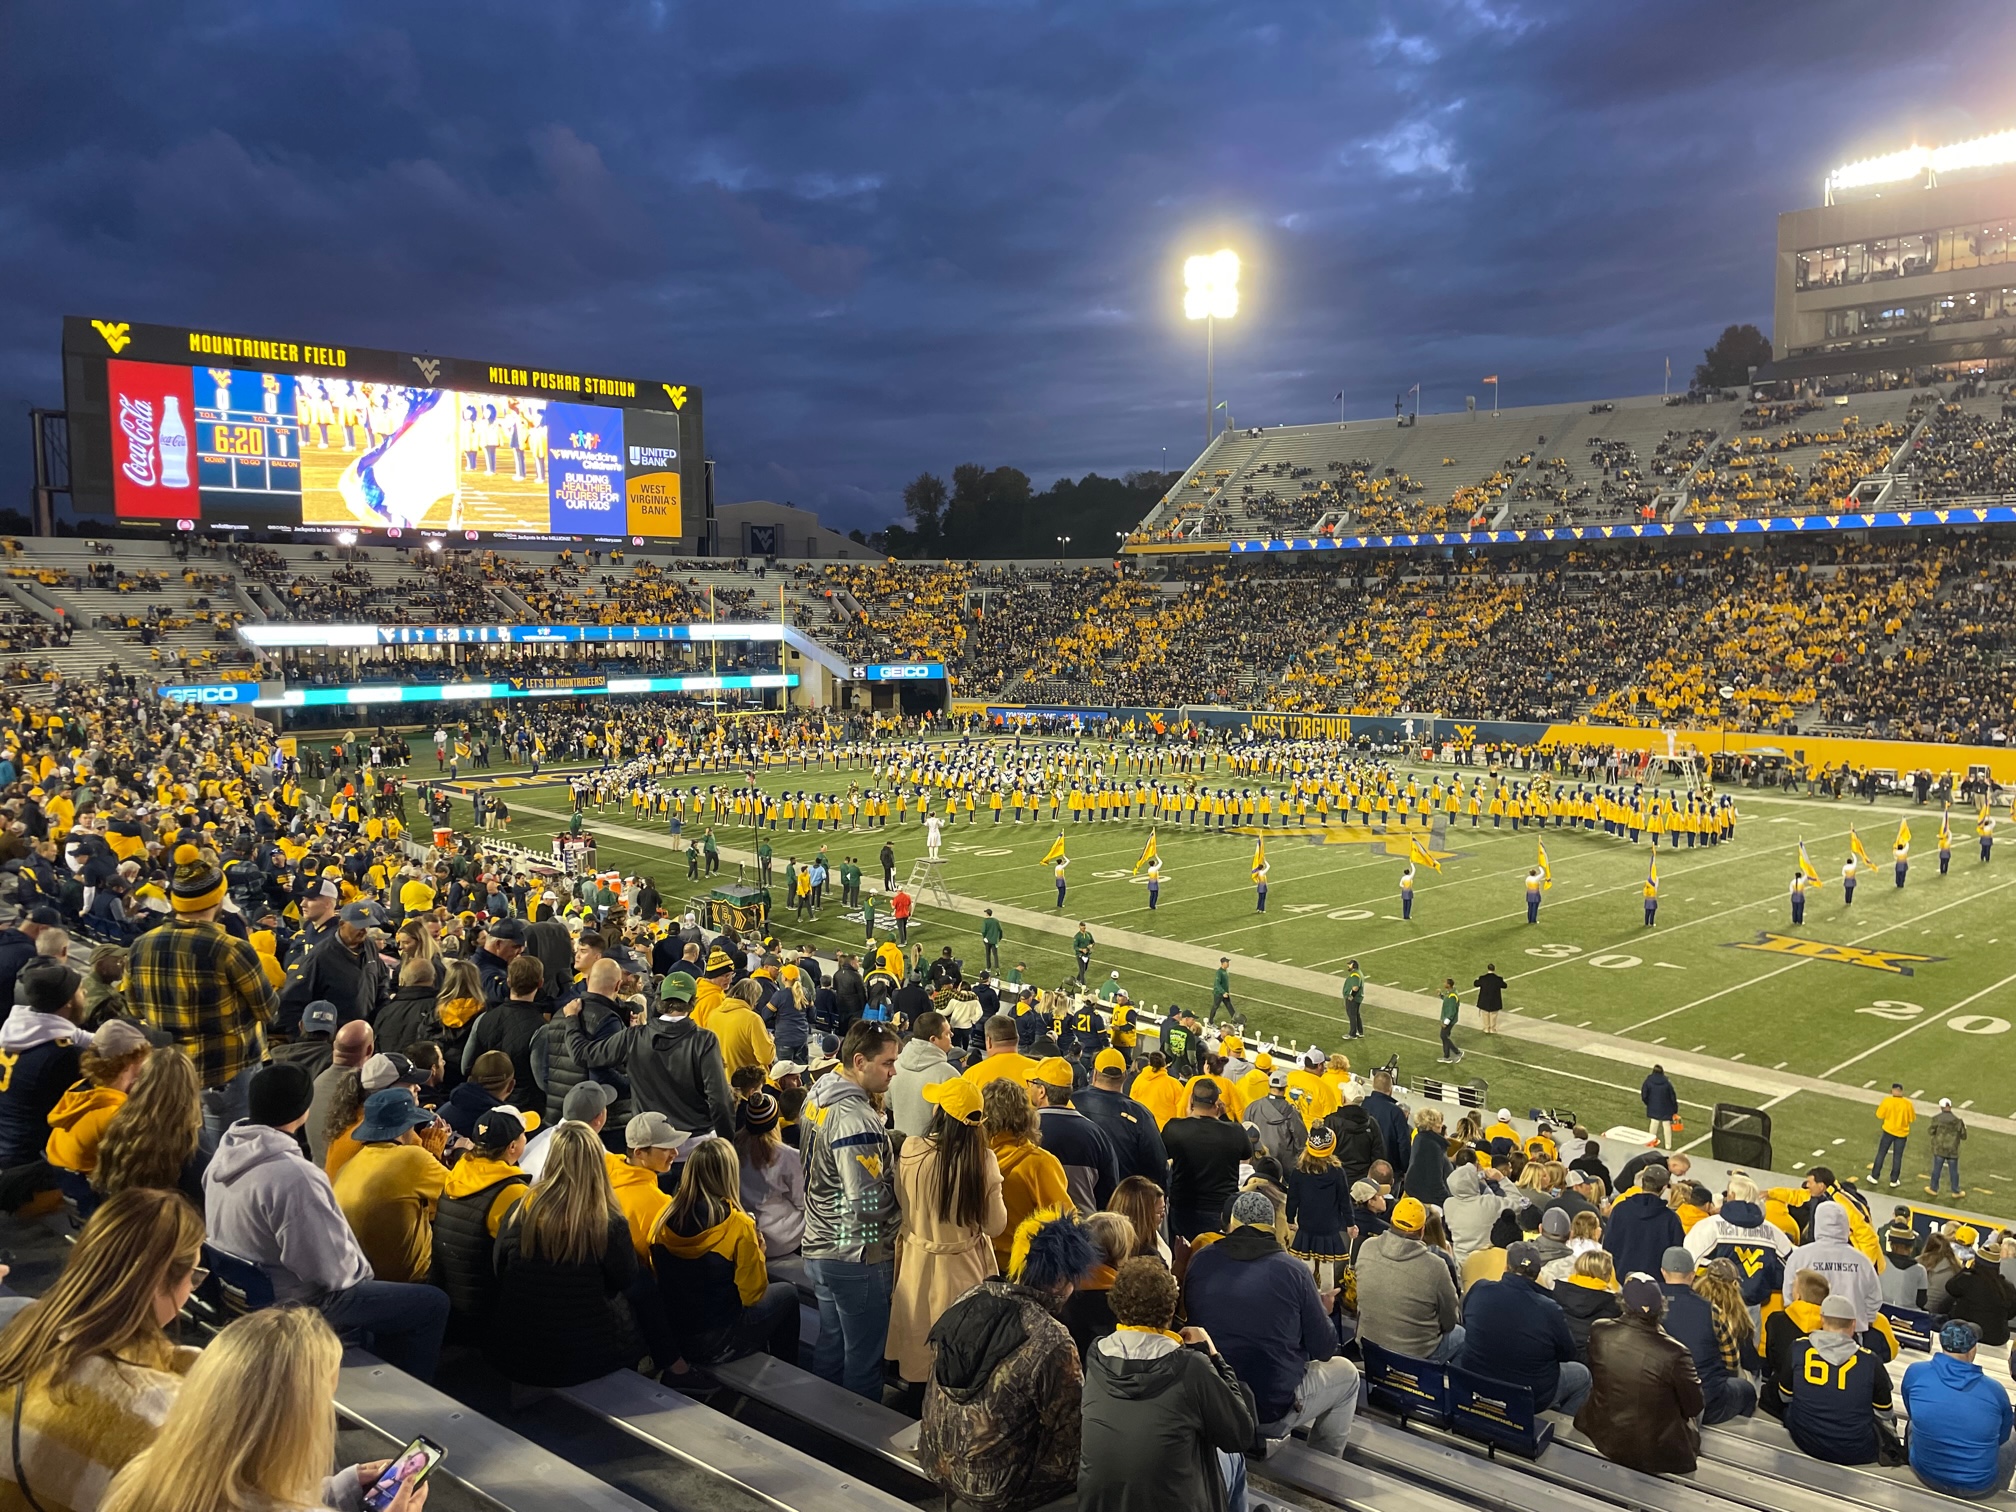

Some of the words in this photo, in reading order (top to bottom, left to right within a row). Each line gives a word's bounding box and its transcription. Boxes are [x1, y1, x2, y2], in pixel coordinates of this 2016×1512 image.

[189, 333, 299, 362] MOUNTAINEER
[304, 346, 347, 367] FIELD
[489, 366, 528, 387] MILAN
[532, 371, 581, 392] PUSKAR
[584, 377, 635, 398] STADIUM
[214, 425, 263, 455] 6:20
[278, 434, 287, 457] 1
[641, 447, 677, 458] UNITED
[641, 457, 667, 467] BANK
[565, 473, 609, 484] BUILDING
[562, 482, 612, 493] HEALTHIER
[640, 484, 666, 494] WEST
[555, 490, 598, 500] FUTURES
[600, 493, 619, 502] FOR
[630, 494, 677, 505] VIRGINIA'S
[566, 500, 587, 509] OUR
[588, 501, 610, 511] KIDS
[641, 505, 667, 515] BANK
[854, 668, 865, 677] 25
[880, 666, 929, 678] GEICO
[525, 678, 543, 689] LET'S
[544, 678, 554, 688] GO
[555, 675, 606, 688] MOUNTAINEERS!
[1288, 716, 1351, 741] VIRGINIA
[1282, 903, 1375, 921] 40
[1524, 944, 1643, 969] 30
[1077, 1014, 1091, 1033] 21
[1854, 1000, 2012, 1035] 20
[1053, 1020, 1062, 1036] 8
[1812, 1261, 1859, 1273] SKAVINSKY
[1804, 1347, 1858, 1390] 67
